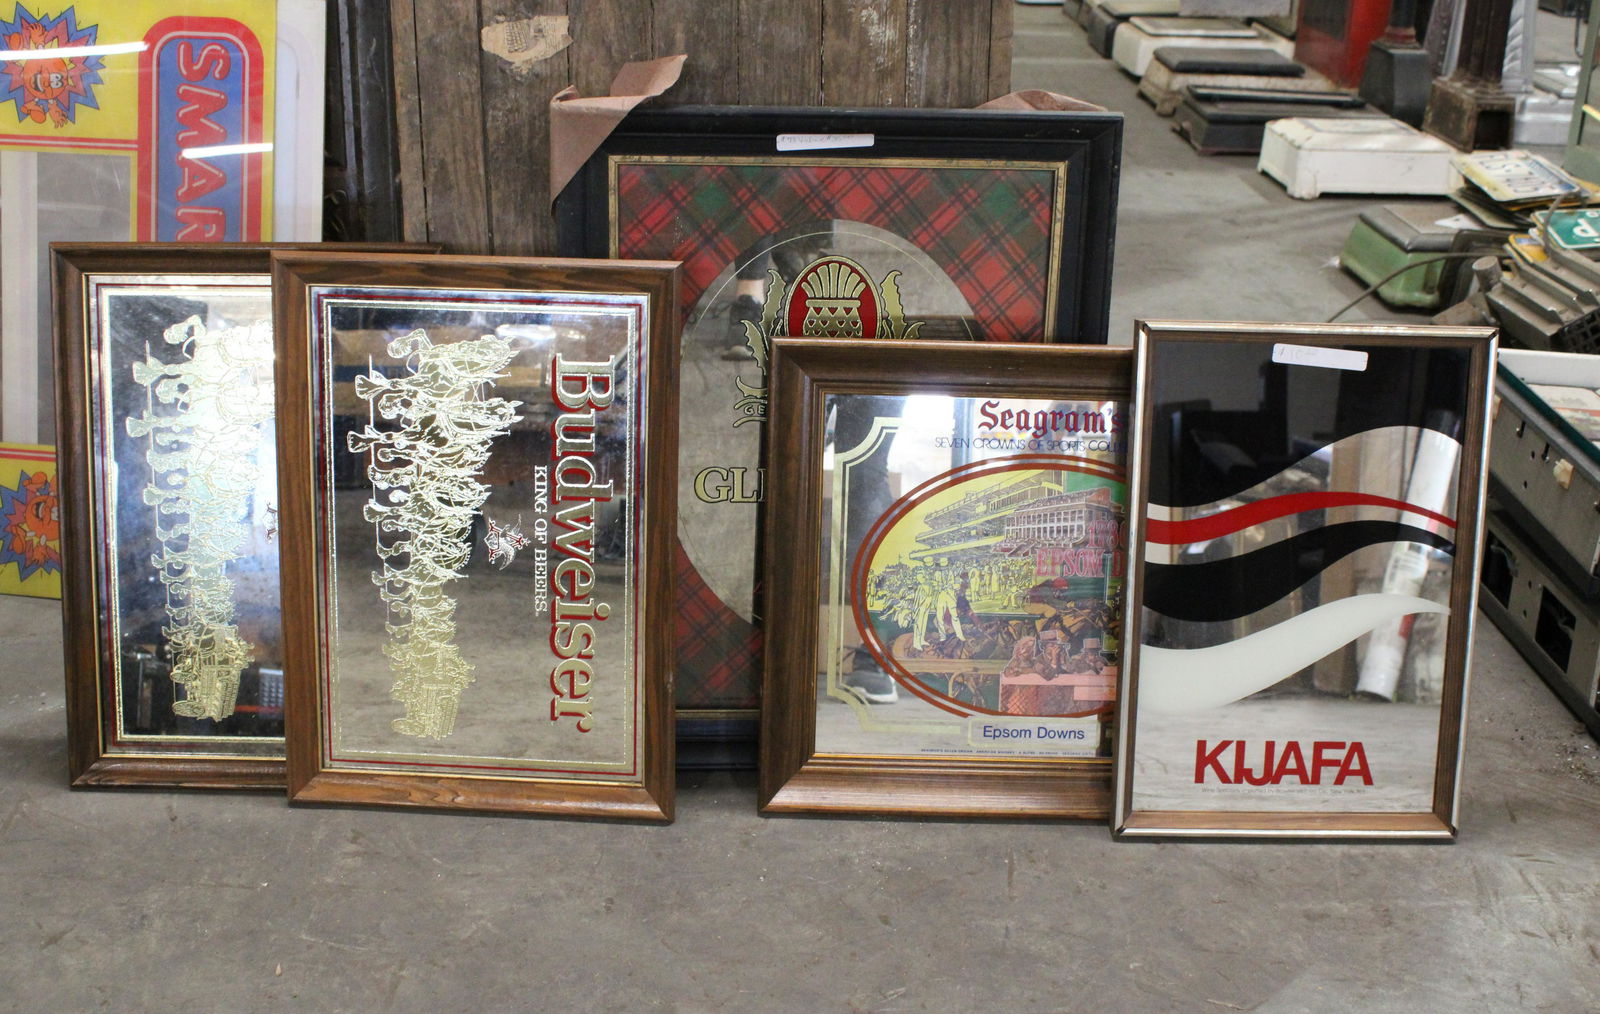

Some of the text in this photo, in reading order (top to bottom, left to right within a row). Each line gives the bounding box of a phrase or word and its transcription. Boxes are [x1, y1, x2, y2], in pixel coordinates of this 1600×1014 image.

[978, 400, 1125, 439] Seagram's
[935, 437, 970, 448] SEVEN
[973, 438, 1026, 450] CROWNS
[1028, 439, 1044, 450] OF
[1046, 440, 1085, 452] SPORTS
[534, 465, 548, 612] KING OF BEERS
[550, 352, 616, 733] Budweiser
[1036, 546, 1105, 578] EPSOM
[983, 725, 1085, 740] Epsom Downs
[1194, 739, 1374, 786] KIJAFA
